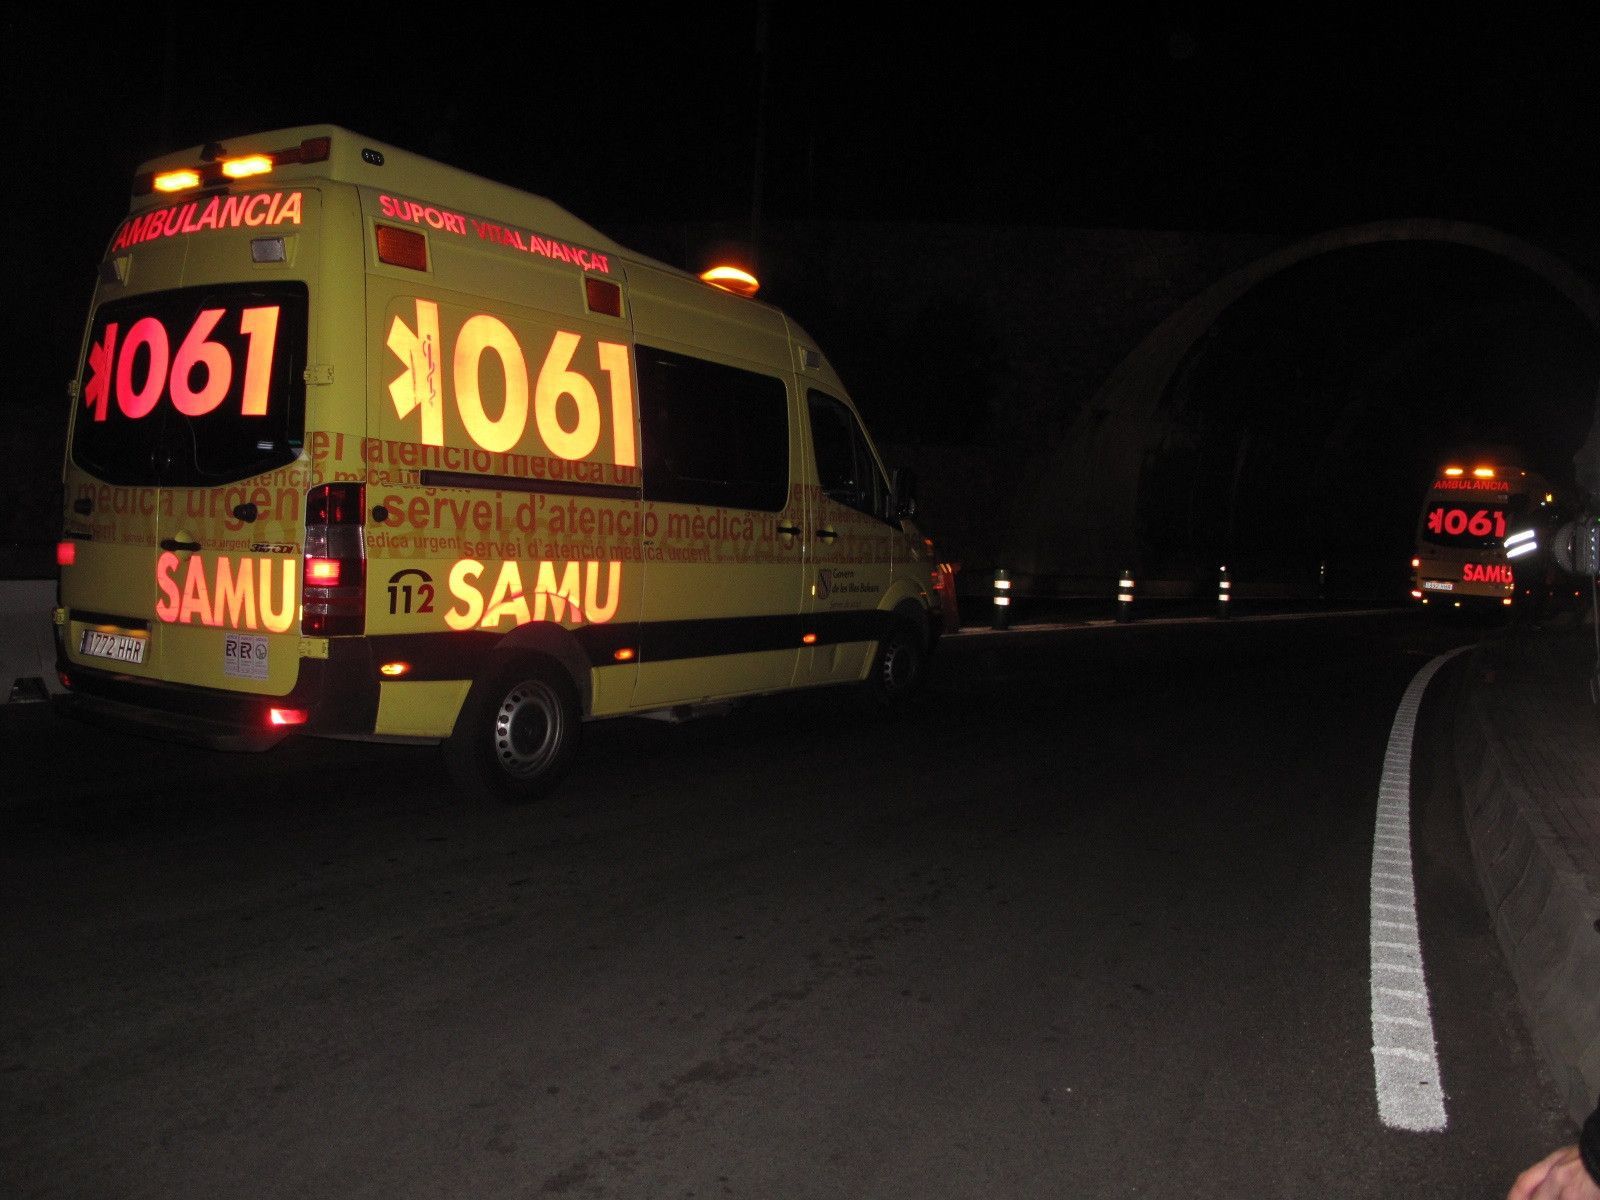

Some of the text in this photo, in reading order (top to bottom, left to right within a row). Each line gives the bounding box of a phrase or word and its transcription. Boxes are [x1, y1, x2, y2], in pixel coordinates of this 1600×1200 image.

[378, 195, 609, 273] SUPORT VITAL AVANÇAT
[116, 306, 280, 419] 061
[453, 314, 636, 467] 061
[380, 492, 502, 530] servei
[1445, 509, 1507, 538] 061
[156, 551, 296, 633] SAMU
[387, 585, 435, 615] 112
[444, 559, 621, 631] SAMU
[1463, 563, 1514, 584] SAMU
[89, 633, 142, 661] 1772 HHR
